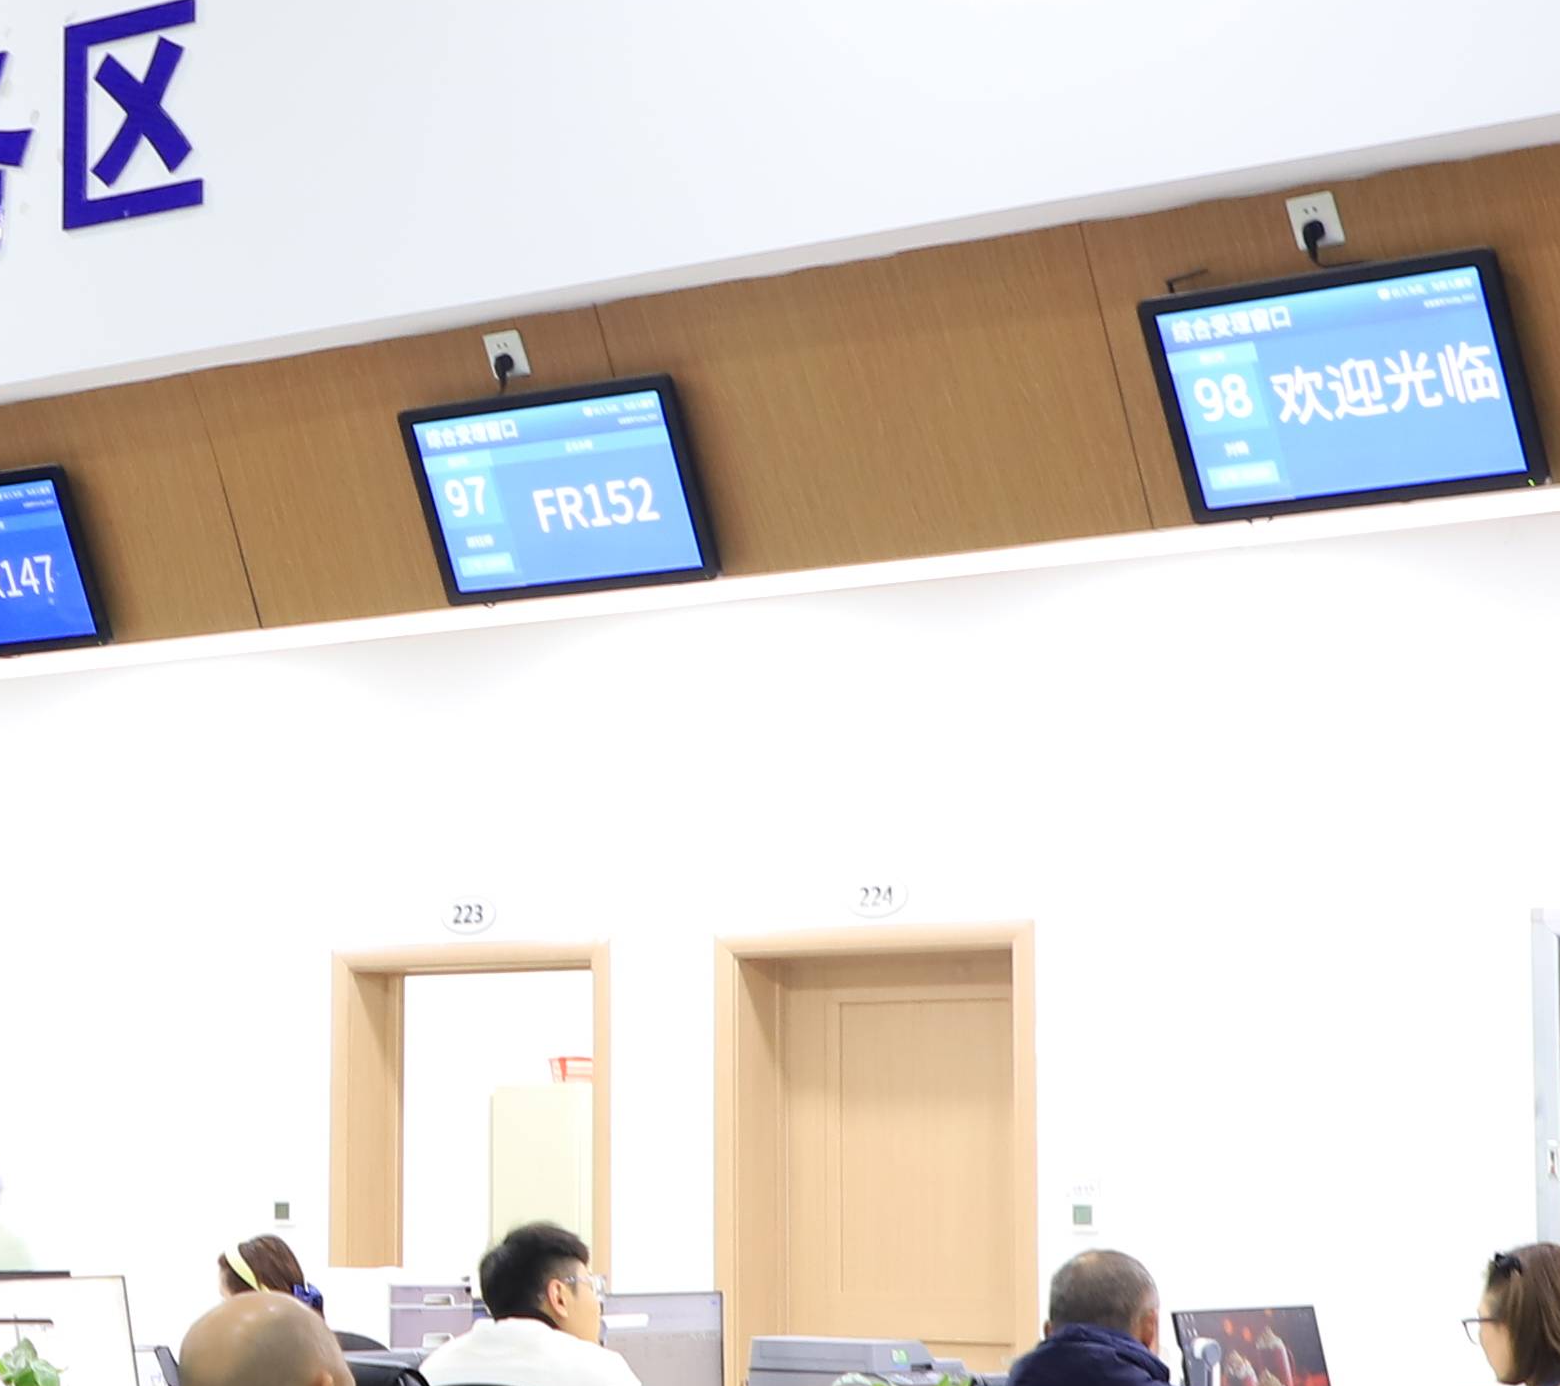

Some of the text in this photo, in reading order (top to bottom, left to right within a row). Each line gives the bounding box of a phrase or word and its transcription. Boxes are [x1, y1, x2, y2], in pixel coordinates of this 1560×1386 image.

[1193, 373, 1254, 422] 98
[1269, 341, 1500, 425] 欢迎光临
[444, 476, 486, 518] 97
[532, 477, 661, 534] FR152
[452, 904, 484, 925] 223
[859, 886, 894, 909] 224
